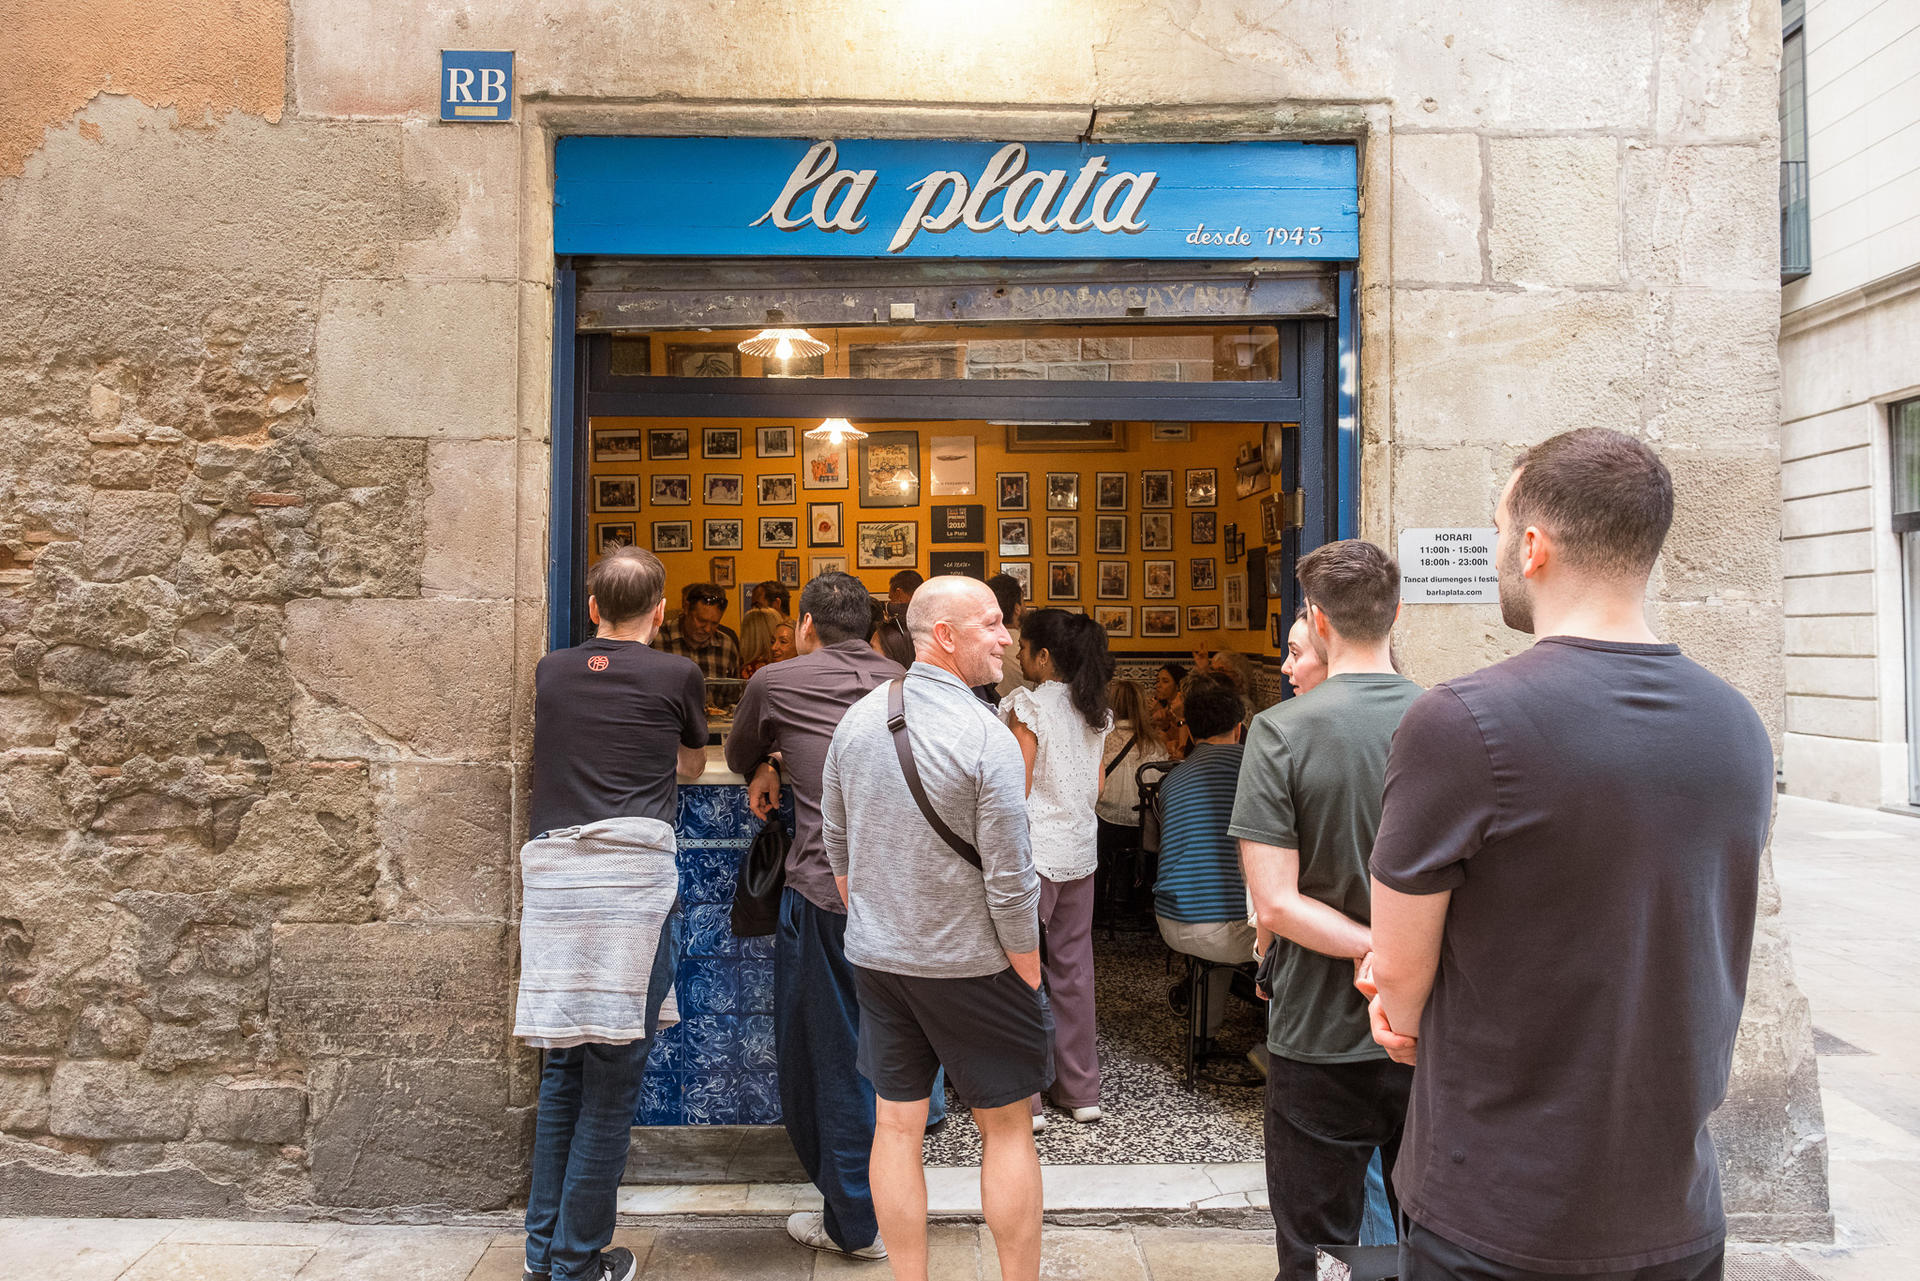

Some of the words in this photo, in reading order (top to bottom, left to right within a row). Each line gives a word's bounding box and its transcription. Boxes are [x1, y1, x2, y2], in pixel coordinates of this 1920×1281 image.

[446, 67, 507, 103] RB
[749, 140, 879, 233] la
[887, 142, 1159, 254] plata
[1185, 223, 1251, 246] desde
[1264, 226, 1323, 246] 1945
[1420, 546, 1450, 554] 11:00h
[1459, 546, 1488, 554] 15:00h
[1420, 558, 1450, 566] 18:00h
[1458, 558, 1488, 566] 23:00h
[1430, 576, 1472, 584] diumenges
[1426, 589, 1482, 597] barlaplata.com
